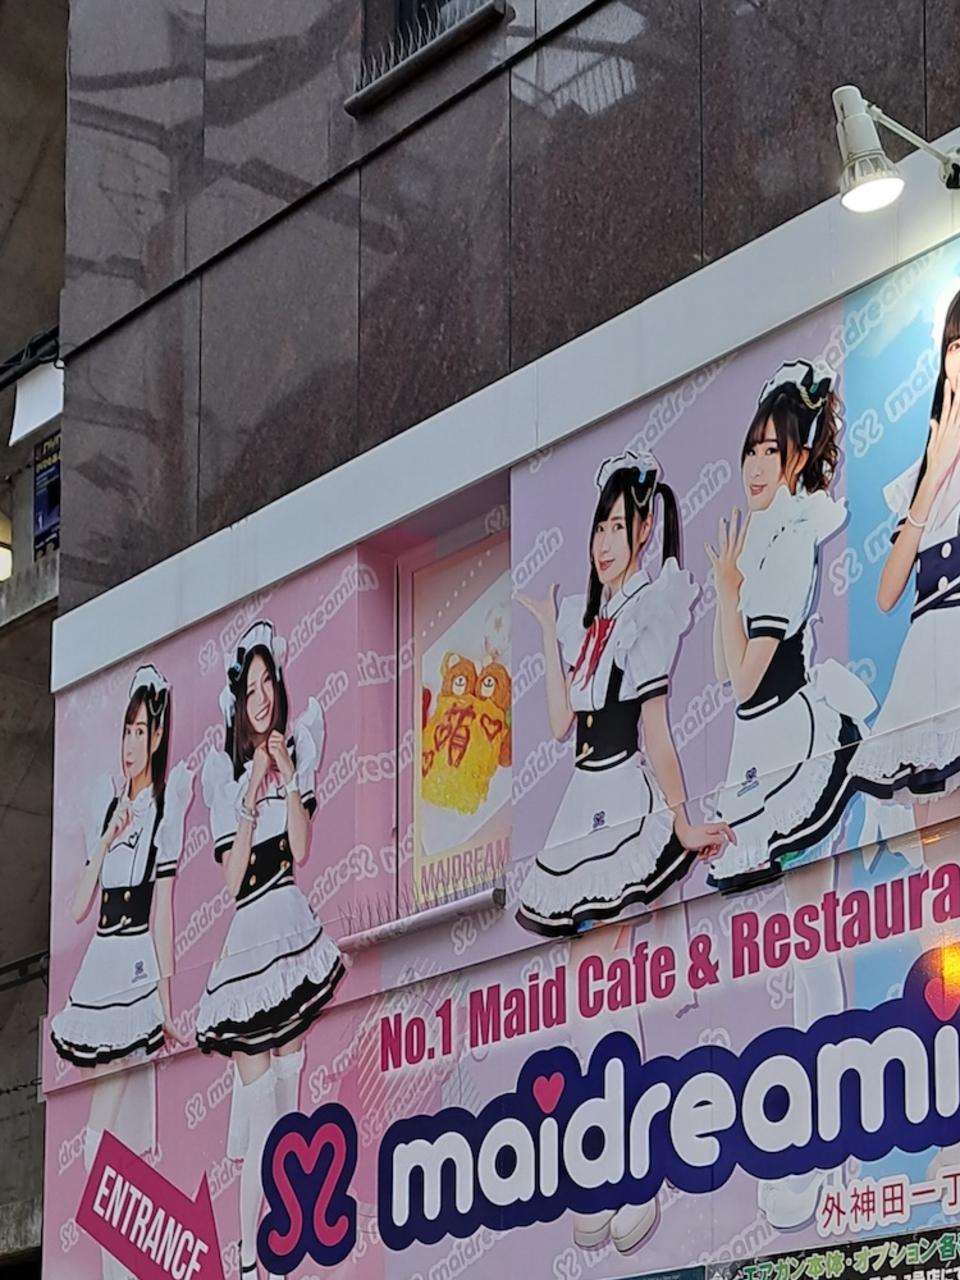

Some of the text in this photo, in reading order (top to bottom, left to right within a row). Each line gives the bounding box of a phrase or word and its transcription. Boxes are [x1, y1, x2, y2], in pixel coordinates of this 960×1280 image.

[381, 998, 452, 1073] No.1
[469, 964, 566, 1048] Maid
[577, 938, 675, 1019] Cafe
[688, 935, 720, 989] &
